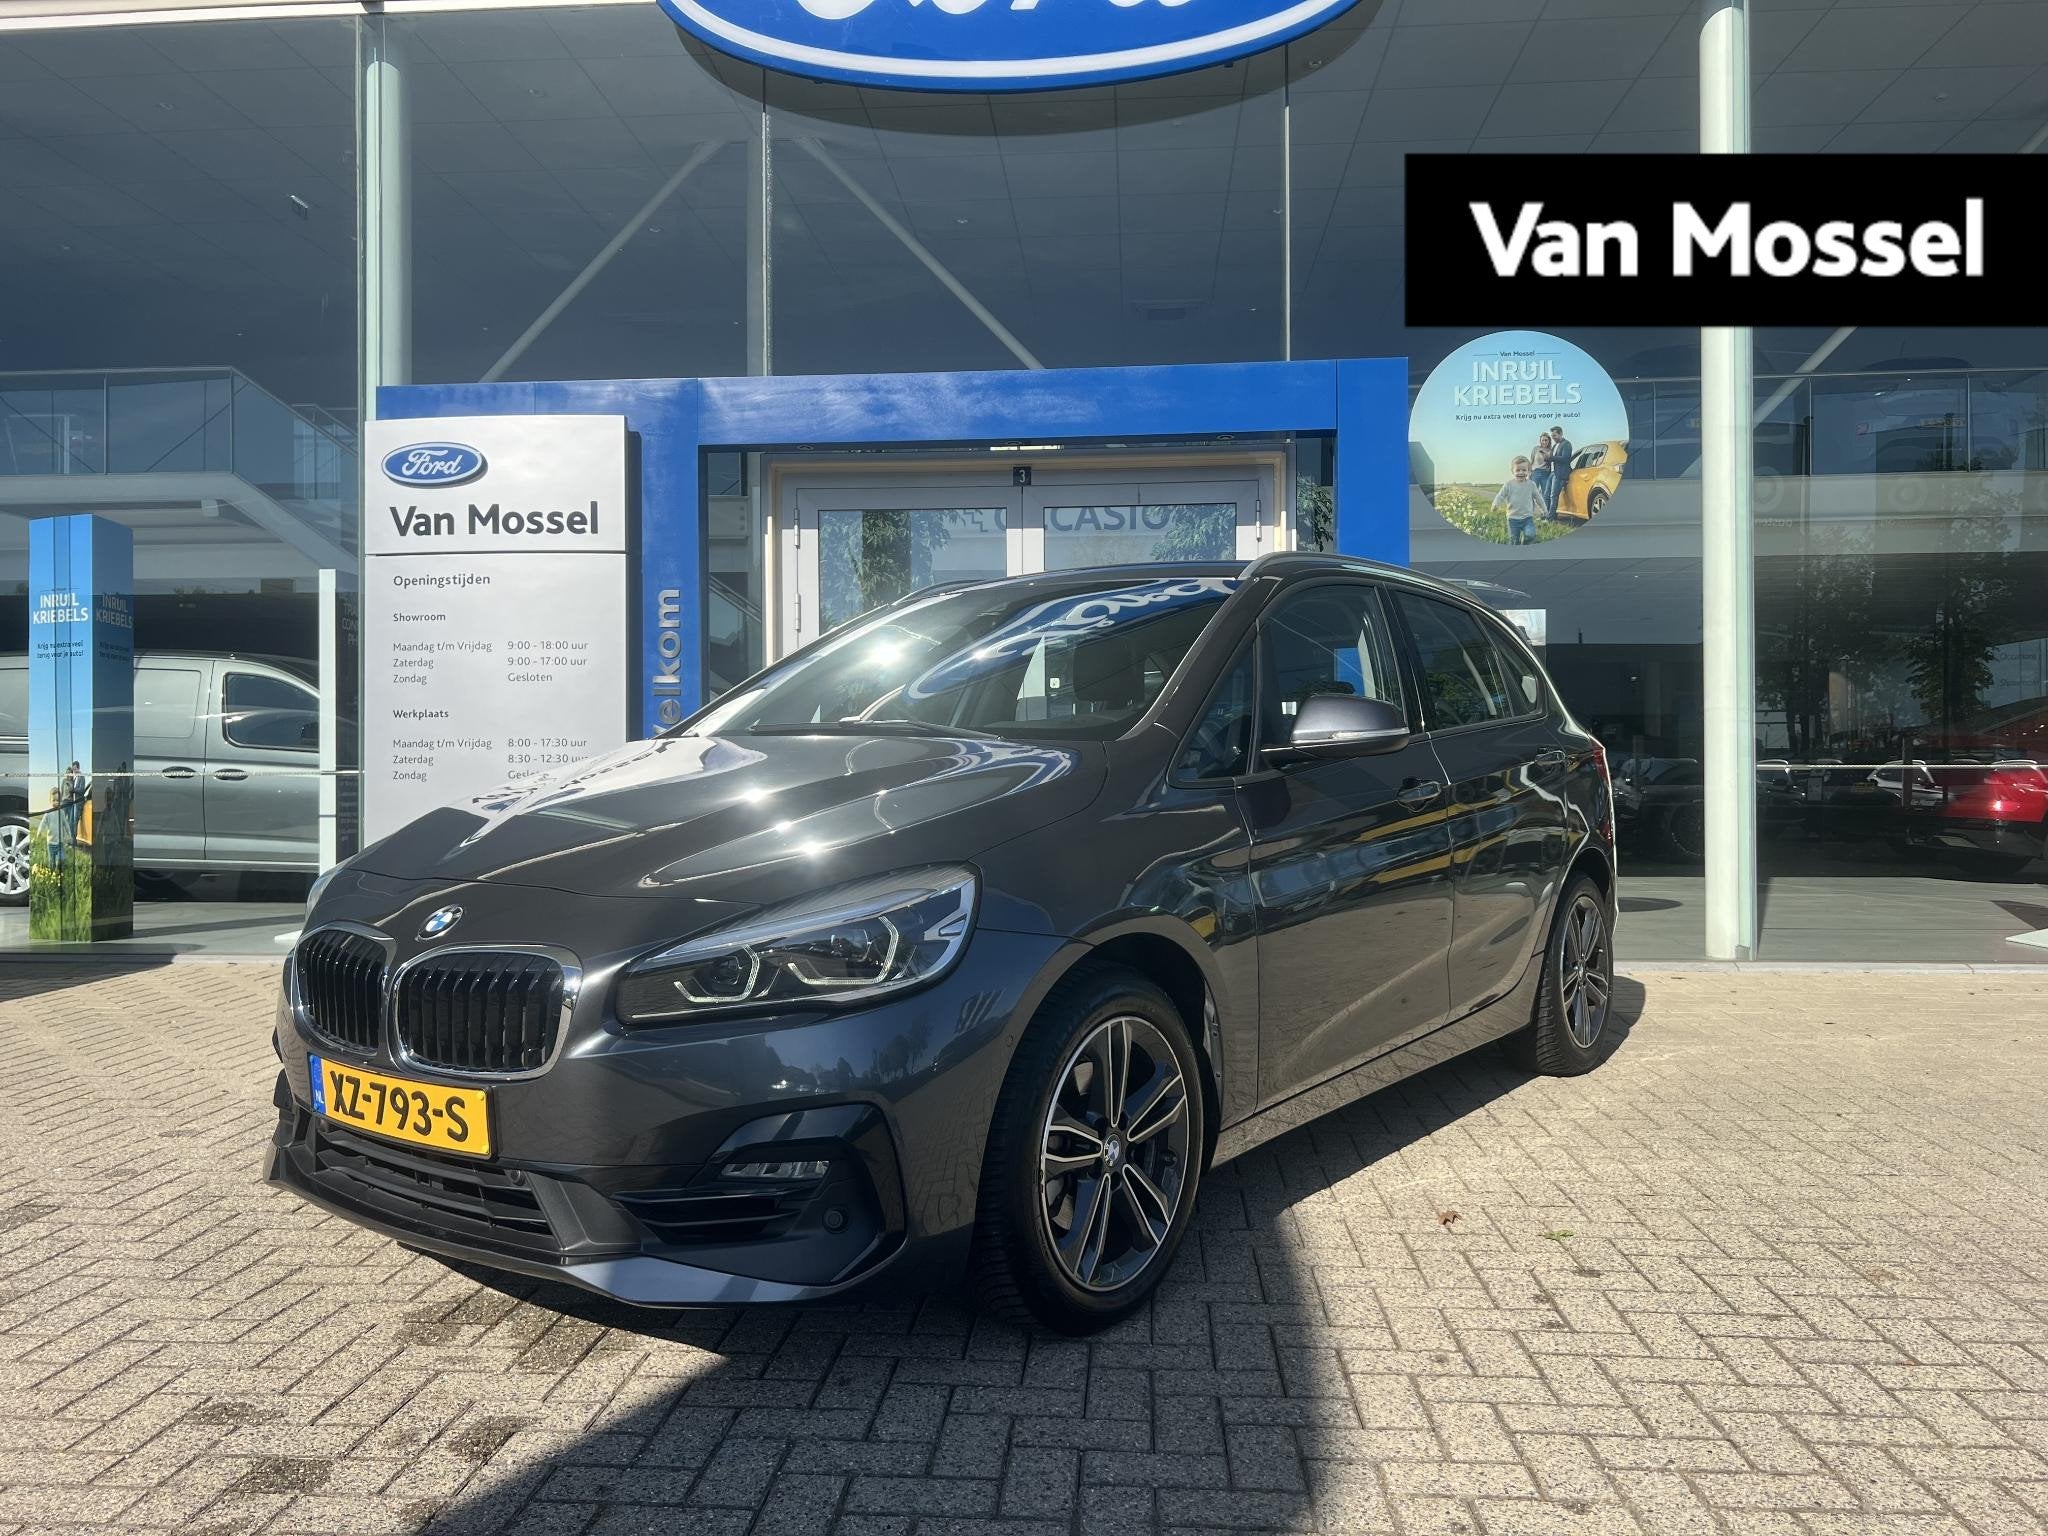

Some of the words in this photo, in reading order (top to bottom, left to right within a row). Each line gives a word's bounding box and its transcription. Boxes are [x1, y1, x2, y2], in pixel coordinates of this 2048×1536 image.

[1472, 359, 1563, 382] INRUIL
[1454, 382, 1582, 406] KRIEBELS
[1456, 414, 1472, 422] Krijg
[1518, 413, 1537, 421] terug
[1554, 412, 1561, 420] je
[402, 449, 463, 476] Ford
[1019, 469, 1026, 483] 3
[389, 505, 455, 537] Van
[468, 501, 599, 535] Mossel
[393, 573, 491, 589] Openingstijden
[40, 592, 80, 609] INRUIL
[33, 607, 88, 624] KRIEBELS
[393, 613, 446, 622] Showroom
[393, 642, 435, 654] Maandag
[437, 642, 455, 652] t/m
[456, 641, 493, 653] Vrijdag
[507, 641, 531, 650] 9:00
[540, 641, 569, 650] 18:00
[571, 642, 589, 650] uur
[393, 658, 434, 669] Zaterdag
[507, 657, 531, 666] 9:00
[540, 657, 568, 666] 17:00
[570, 658, 588, 666] uur
[393, 674, 427, 685] Zondag
[507, 672, 553, 682] Gesloten
[393, 709, 450, 721] Werkplaats
[393, 739, 435, 750] Maandag
[437, 738, 455, 748] t/m
[457, 738, 493, 750] Vrijdag
[507, 738, 531, 748] 8:00
[540, 738, 568, 748] 17:30
[570, 739, 588, 748] uur
[393, 755, 434, 766] Zaterdag
[507, 754, 531, 763] 8:30
[540, 754, 569, 763] 12:30
[393, 771, 427, 782] Zondag
[330, 1070, 469, 1143] XZ-793-S
